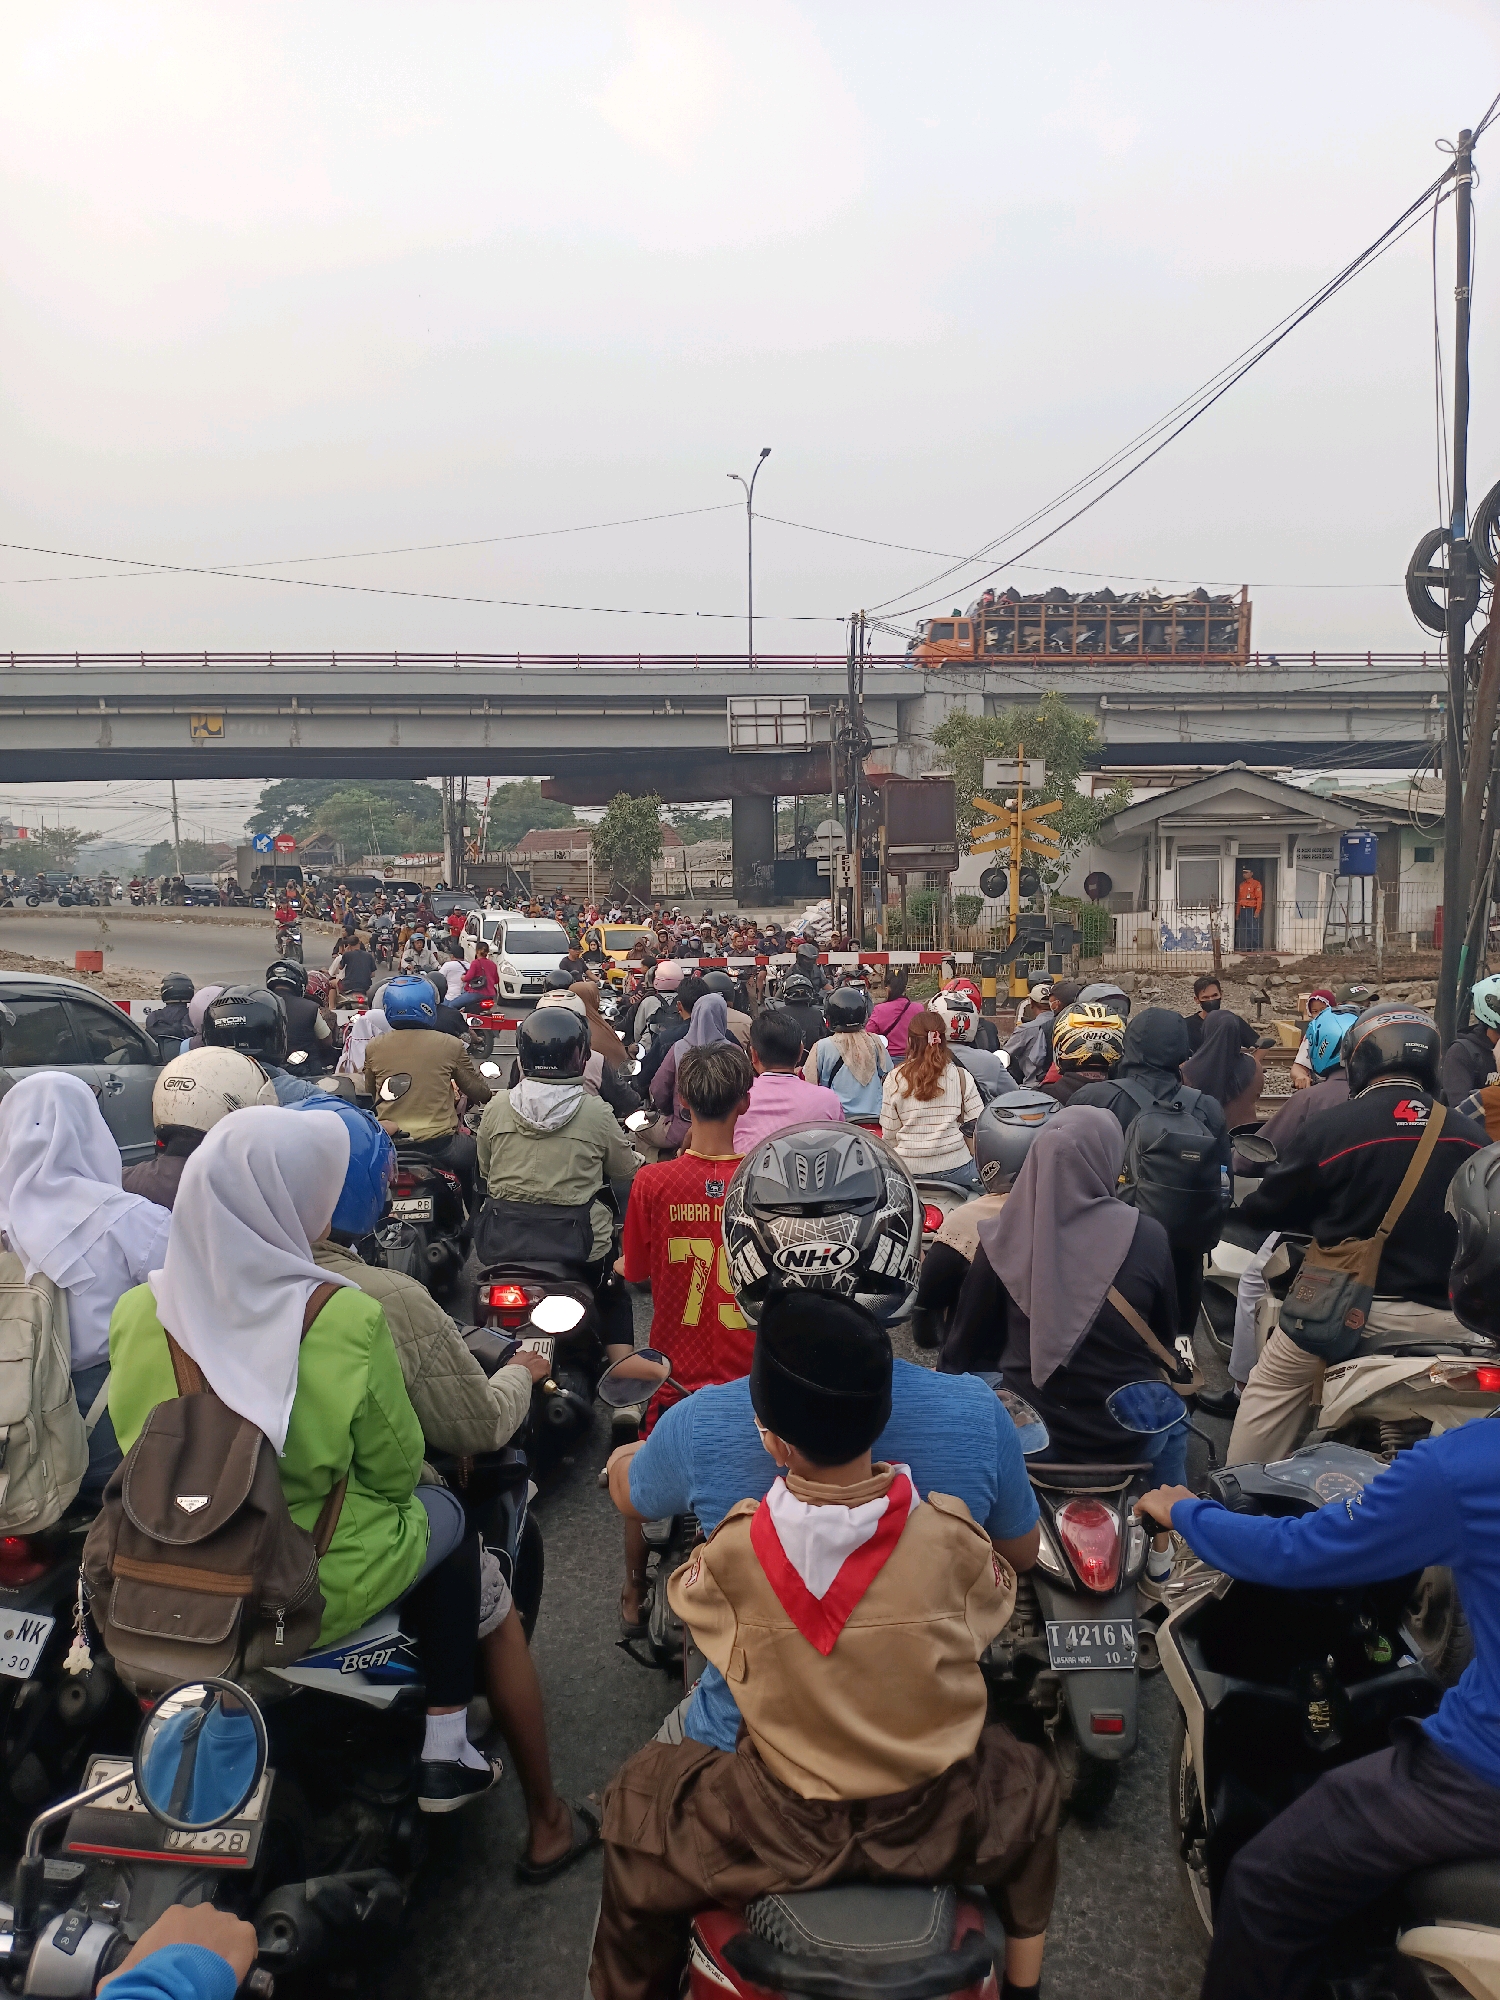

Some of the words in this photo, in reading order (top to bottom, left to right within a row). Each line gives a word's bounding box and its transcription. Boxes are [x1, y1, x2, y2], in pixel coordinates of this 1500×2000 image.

[166, 1079, 192, 1088] BMC
[780, 1247, 845, 1269] NHK
[15, 1619, 47, 1645] NK
[1048, 1626, 1059, 1647] T
[1065, 1625, 1116, 1647] 4216
[1105, 1651, 1120, 1663] 10
